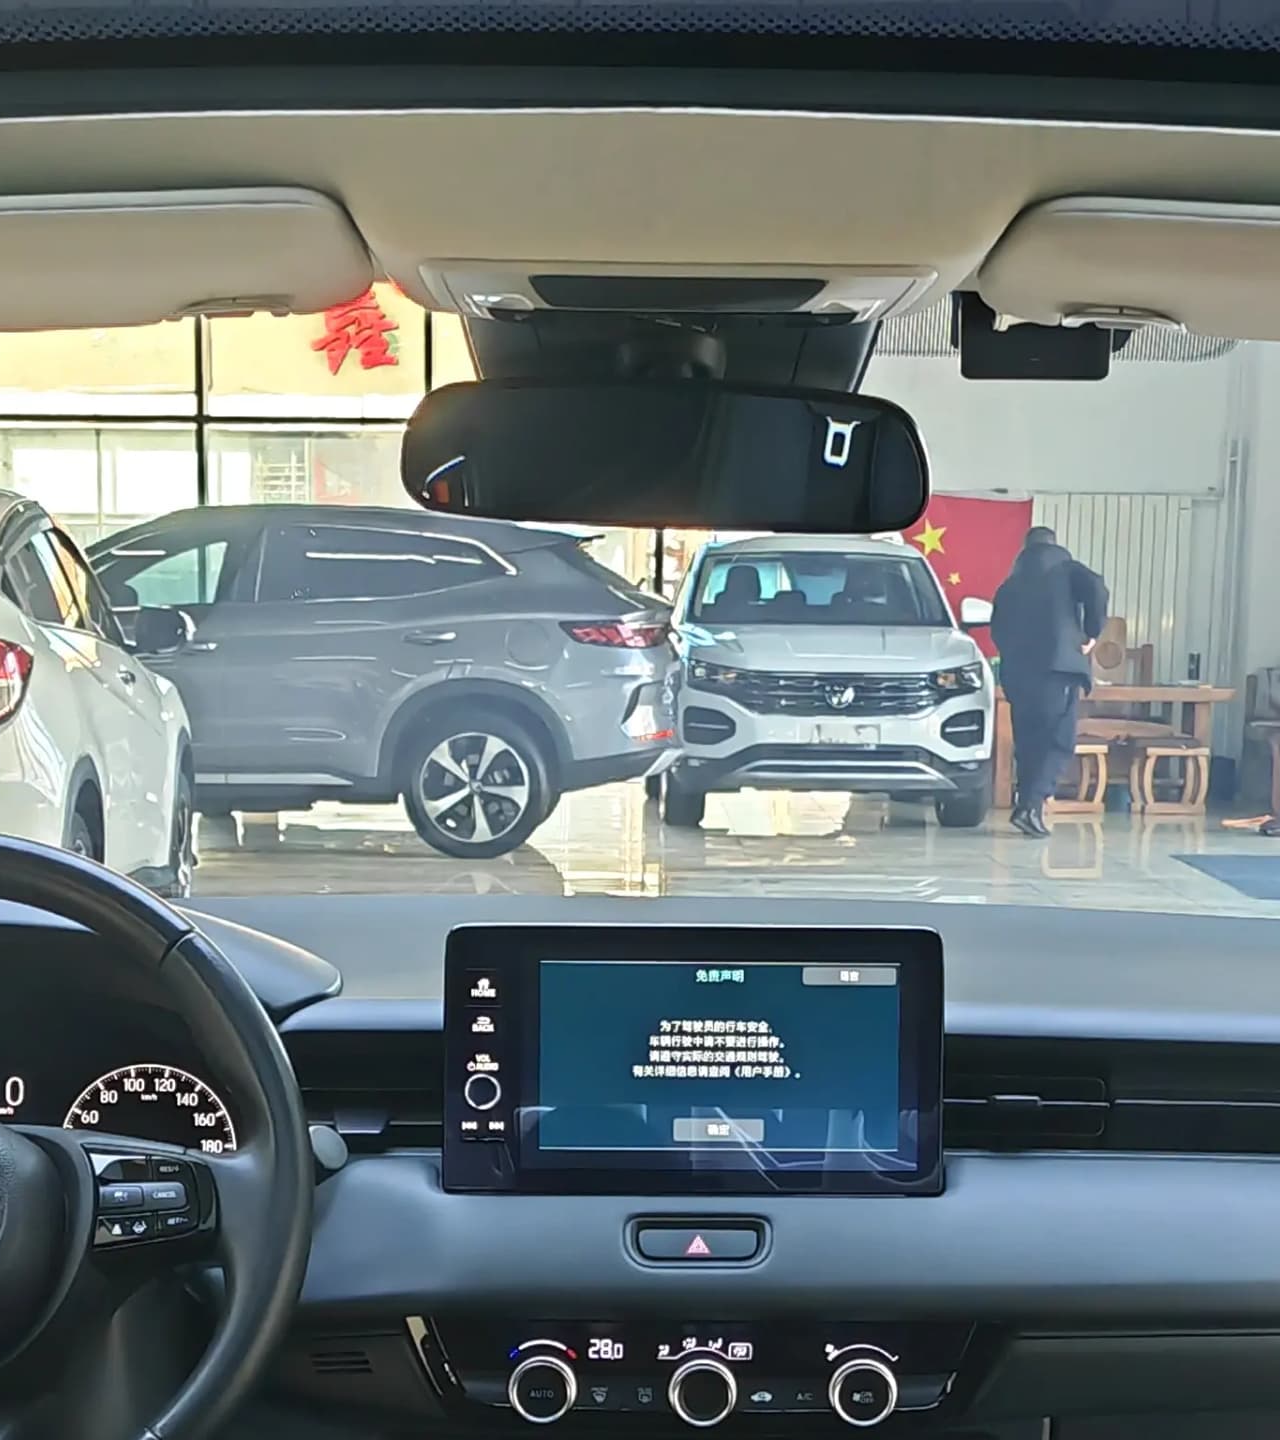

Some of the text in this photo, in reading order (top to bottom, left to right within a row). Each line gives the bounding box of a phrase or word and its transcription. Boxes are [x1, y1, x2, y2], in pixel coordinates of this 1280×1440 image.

[695, 969, 745, 983] 免责声明
[475, 1054, 491, 1063] VOL
[5, 1076, 25, 1107] 0
[123, 1079, 145, 1092] 100
[154, 1079, 176, 1092] 120
[100, 1090, 118, 1104] 80
[176, 1093, 198, 1106] 140
[80, 1110, 99, 1124] 60
[193, 1113, 216, 1127] 160
[200, 1139, 223, 1153] 180
[588, 1338, 624, 1360] 28.0
[529, 1389, 554, 1398] AUTO
[796, 1392, 814, 1401] A/C
